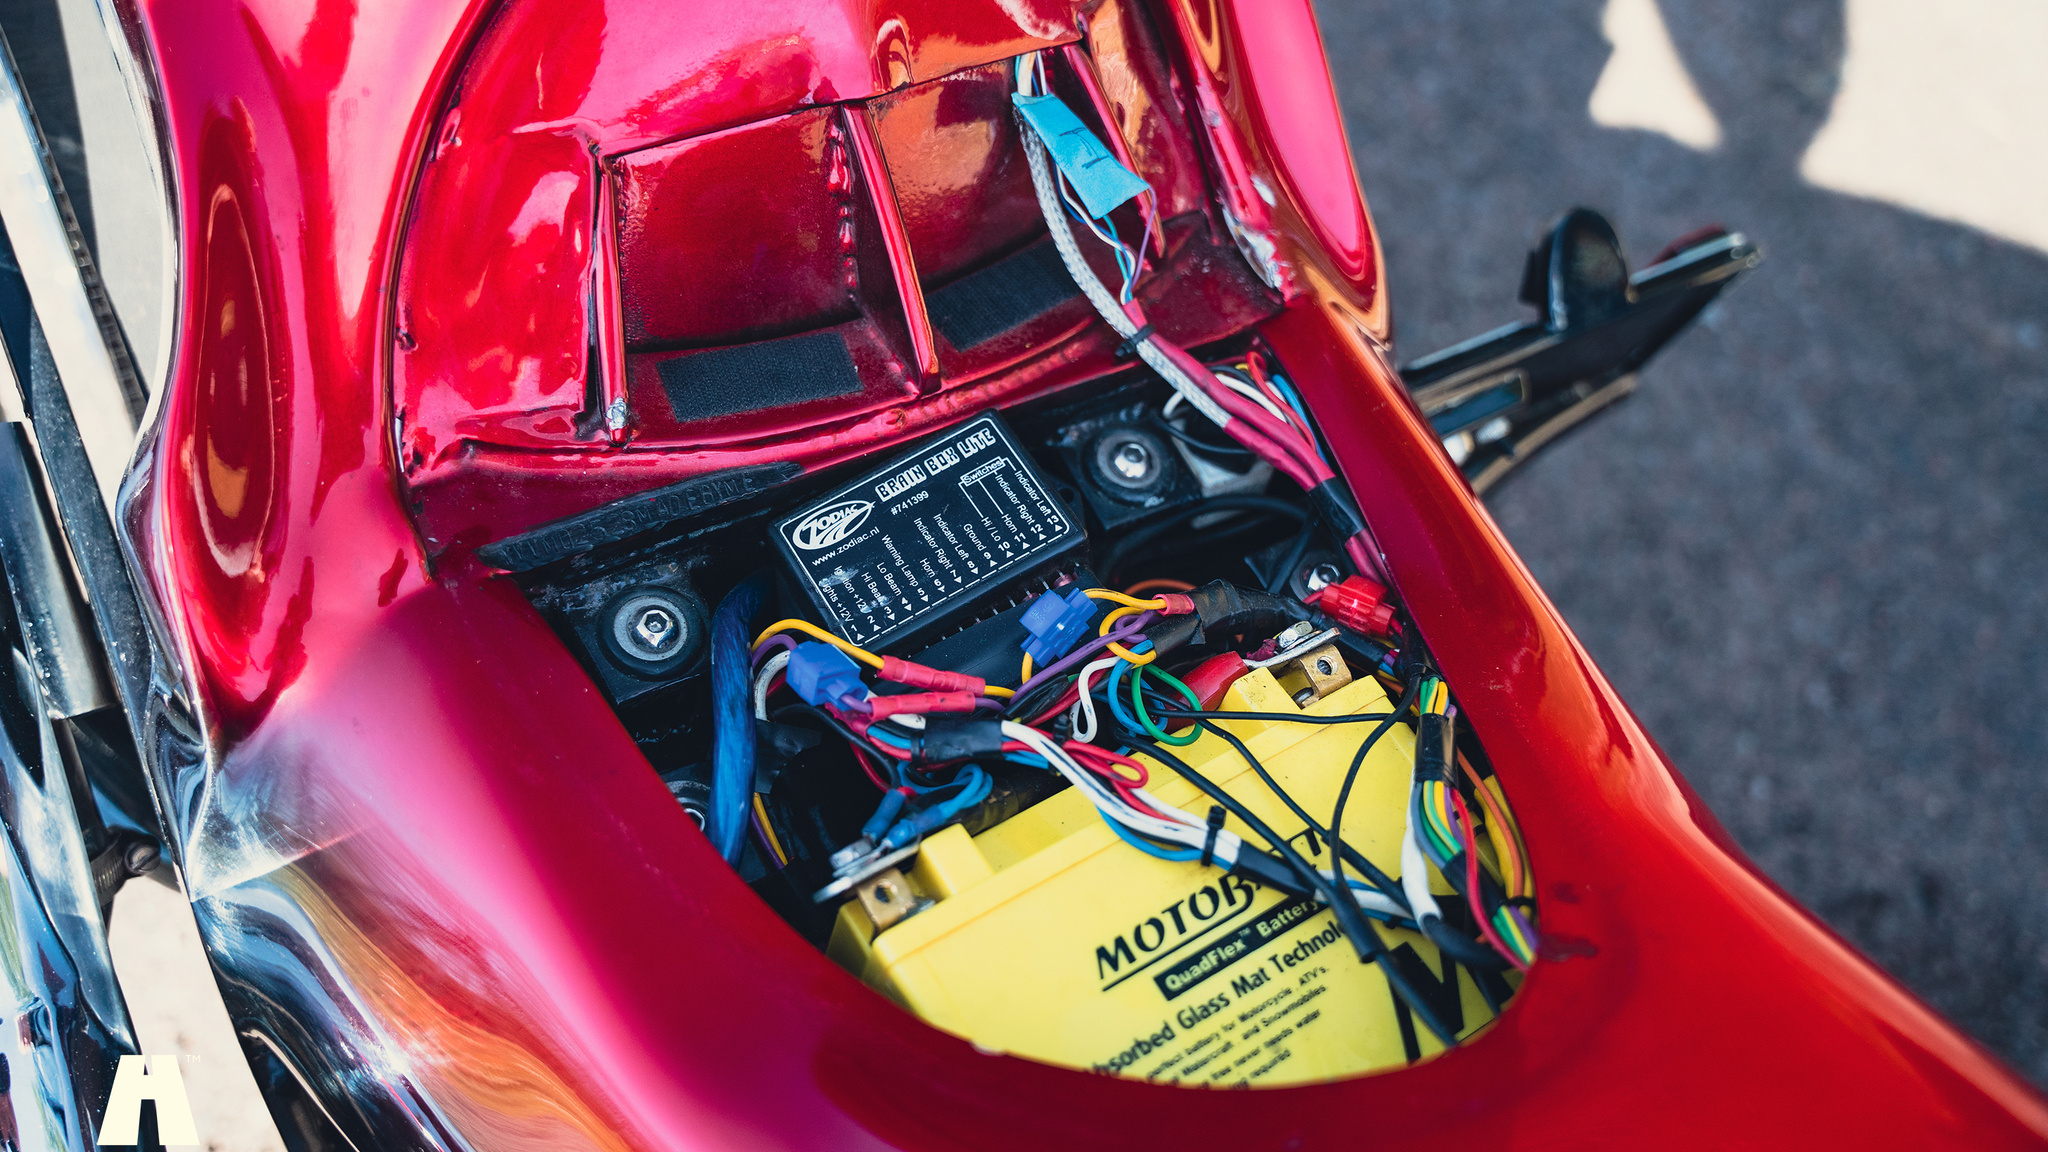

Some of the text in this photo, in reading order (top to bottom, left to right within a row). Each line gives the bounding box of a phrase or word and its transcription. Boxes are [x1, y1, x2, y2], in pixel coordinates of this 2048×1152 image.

[876, 428, 996, 502] BRAIN BOX LITE
[963, 460, 1001, 484] Switches
[891, 490, 929, 516] #741399
[995, 474, 1043, 533] Indicator Right 12
[1015, 470, 1059, 524] Indicator Left 13
[802, 504, 858, 542] ZODIAC
[933, 513, 958, 545] Indicator
[955, 544, 970, 560] Left
[964, 524, 986, 551] Ground
[981, 517, 992, 527] Hi
[990, 530, 1000, 541] Lo
[998, 542, 1010, 551] 10
[1001, 514, 1026, 542] Horn 11
[812, 527, 879, 566] www.zodiac.nl
[881, 534, 904, 566] Warning
[901, 565, 919, 587] Lamp
[913, 517, 939, 549] Indicator
[934, 548, 953, 569] Right
[876, 562, 886, 574] Lo
[884, 572, 902, 596] Beam
[920, 558, 936, 577] Horn
[820, 579, 839, 603] ights
[837, 602, 854, 622] +12V
[833, 565, 855, 594] Igtion
[867, 615, 875, 623] 2
[861, 571, 891, 614] Hi Bea 3
[1256, 900, 1320, 938] Battery
[1177, 993, 1231, 1030] Glass
[1231, 966, 1271, 998] Mat
[1241, 1026, 1260, 1041] and
[1295, 1009, 1322, 1028] water
